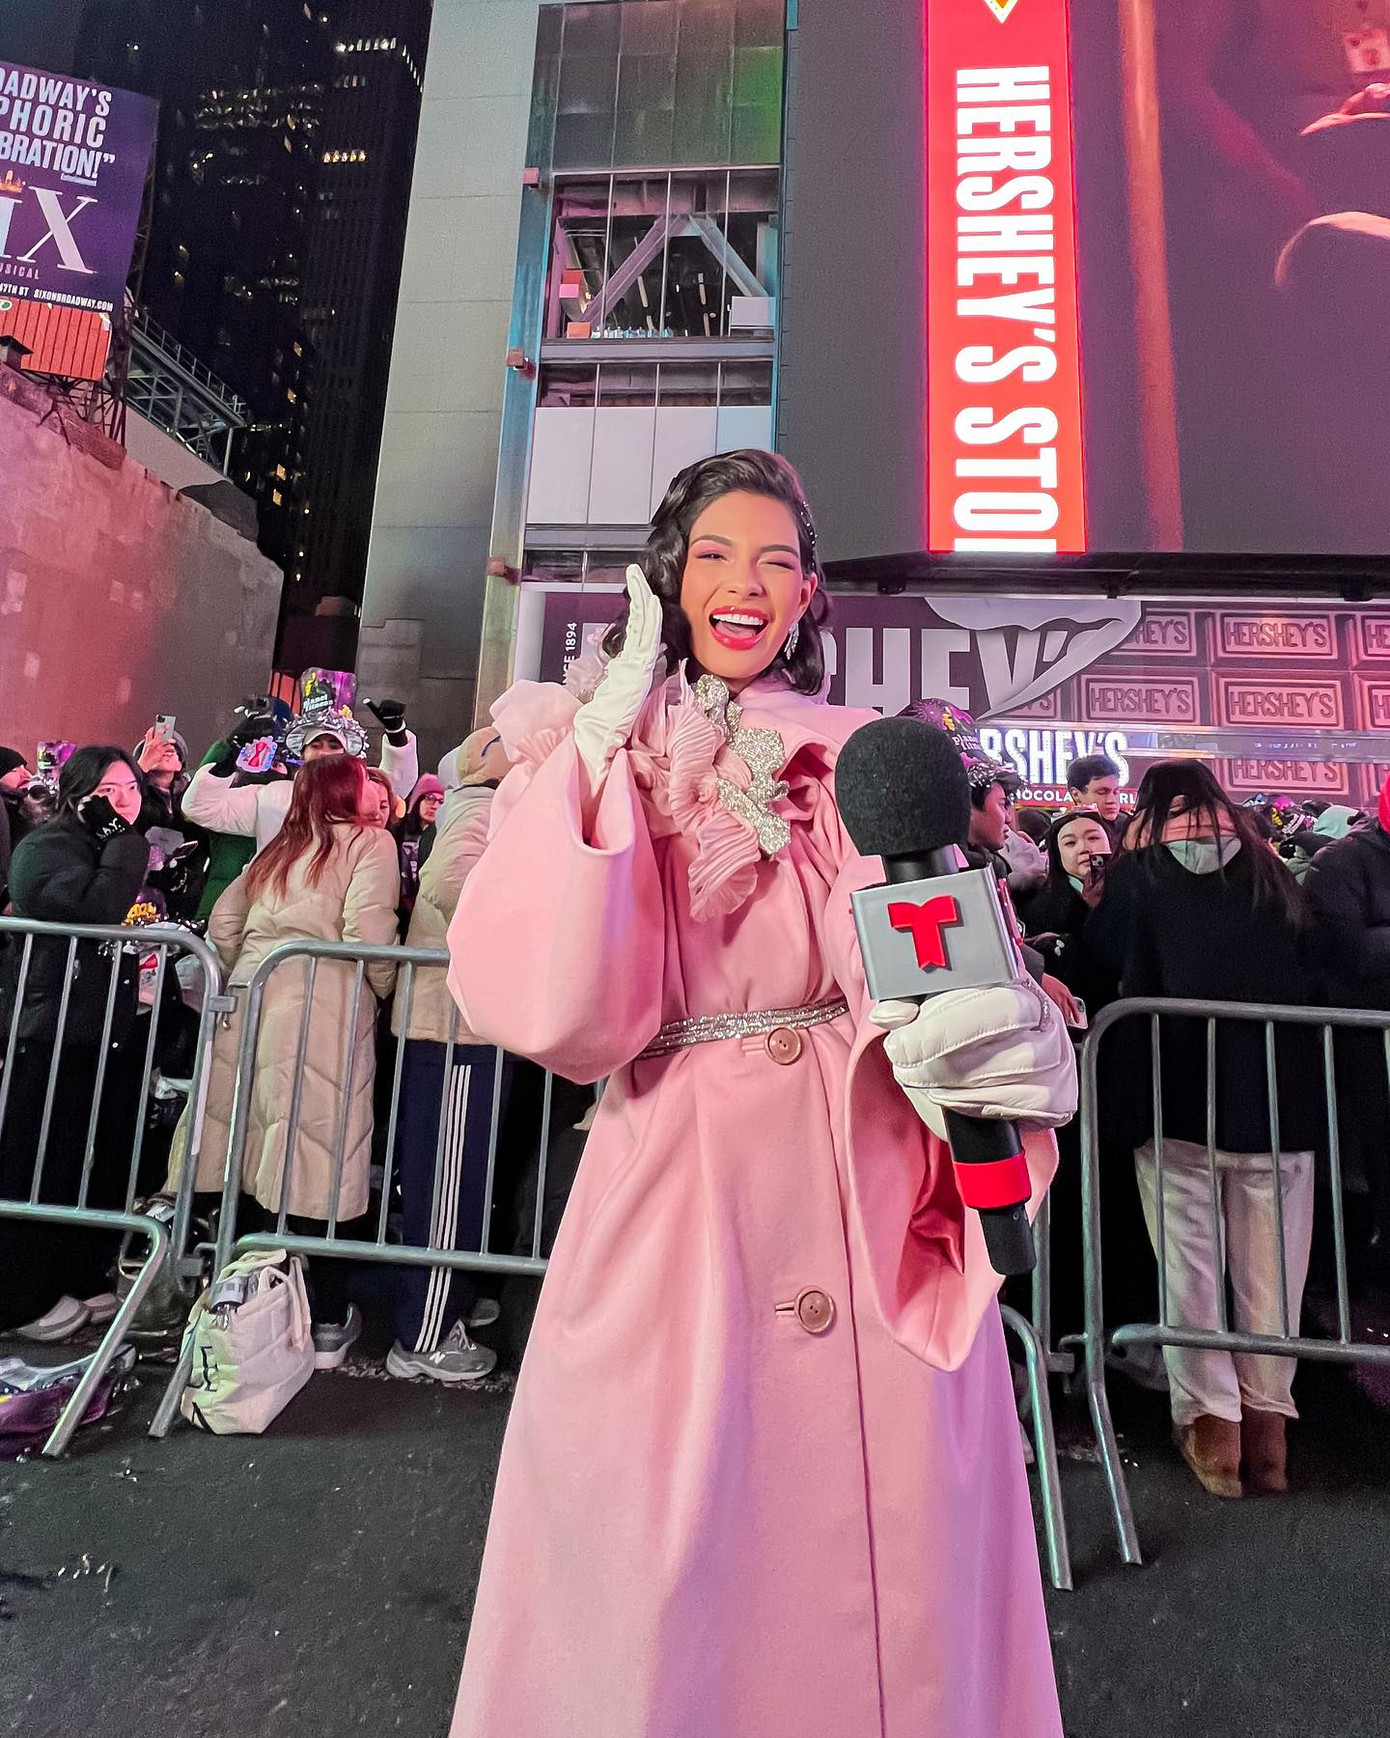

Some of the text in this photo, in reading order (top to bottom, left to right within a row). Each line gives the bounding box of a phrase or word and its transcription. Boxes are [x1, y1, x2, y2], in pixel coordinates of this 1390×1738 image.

[955, 66, 1058, 383] HERSHEY'S
[34, 288, 114, 312] SIXONBROADWAY.COM
[565, 622, 577, 652] 1894
[1226, 621, 1327, 649] HERSHEY'S
[1090, 687, 1191, 715] HERSHEY'S
[1230, 691, 1334, 718] HERSHEY'S
